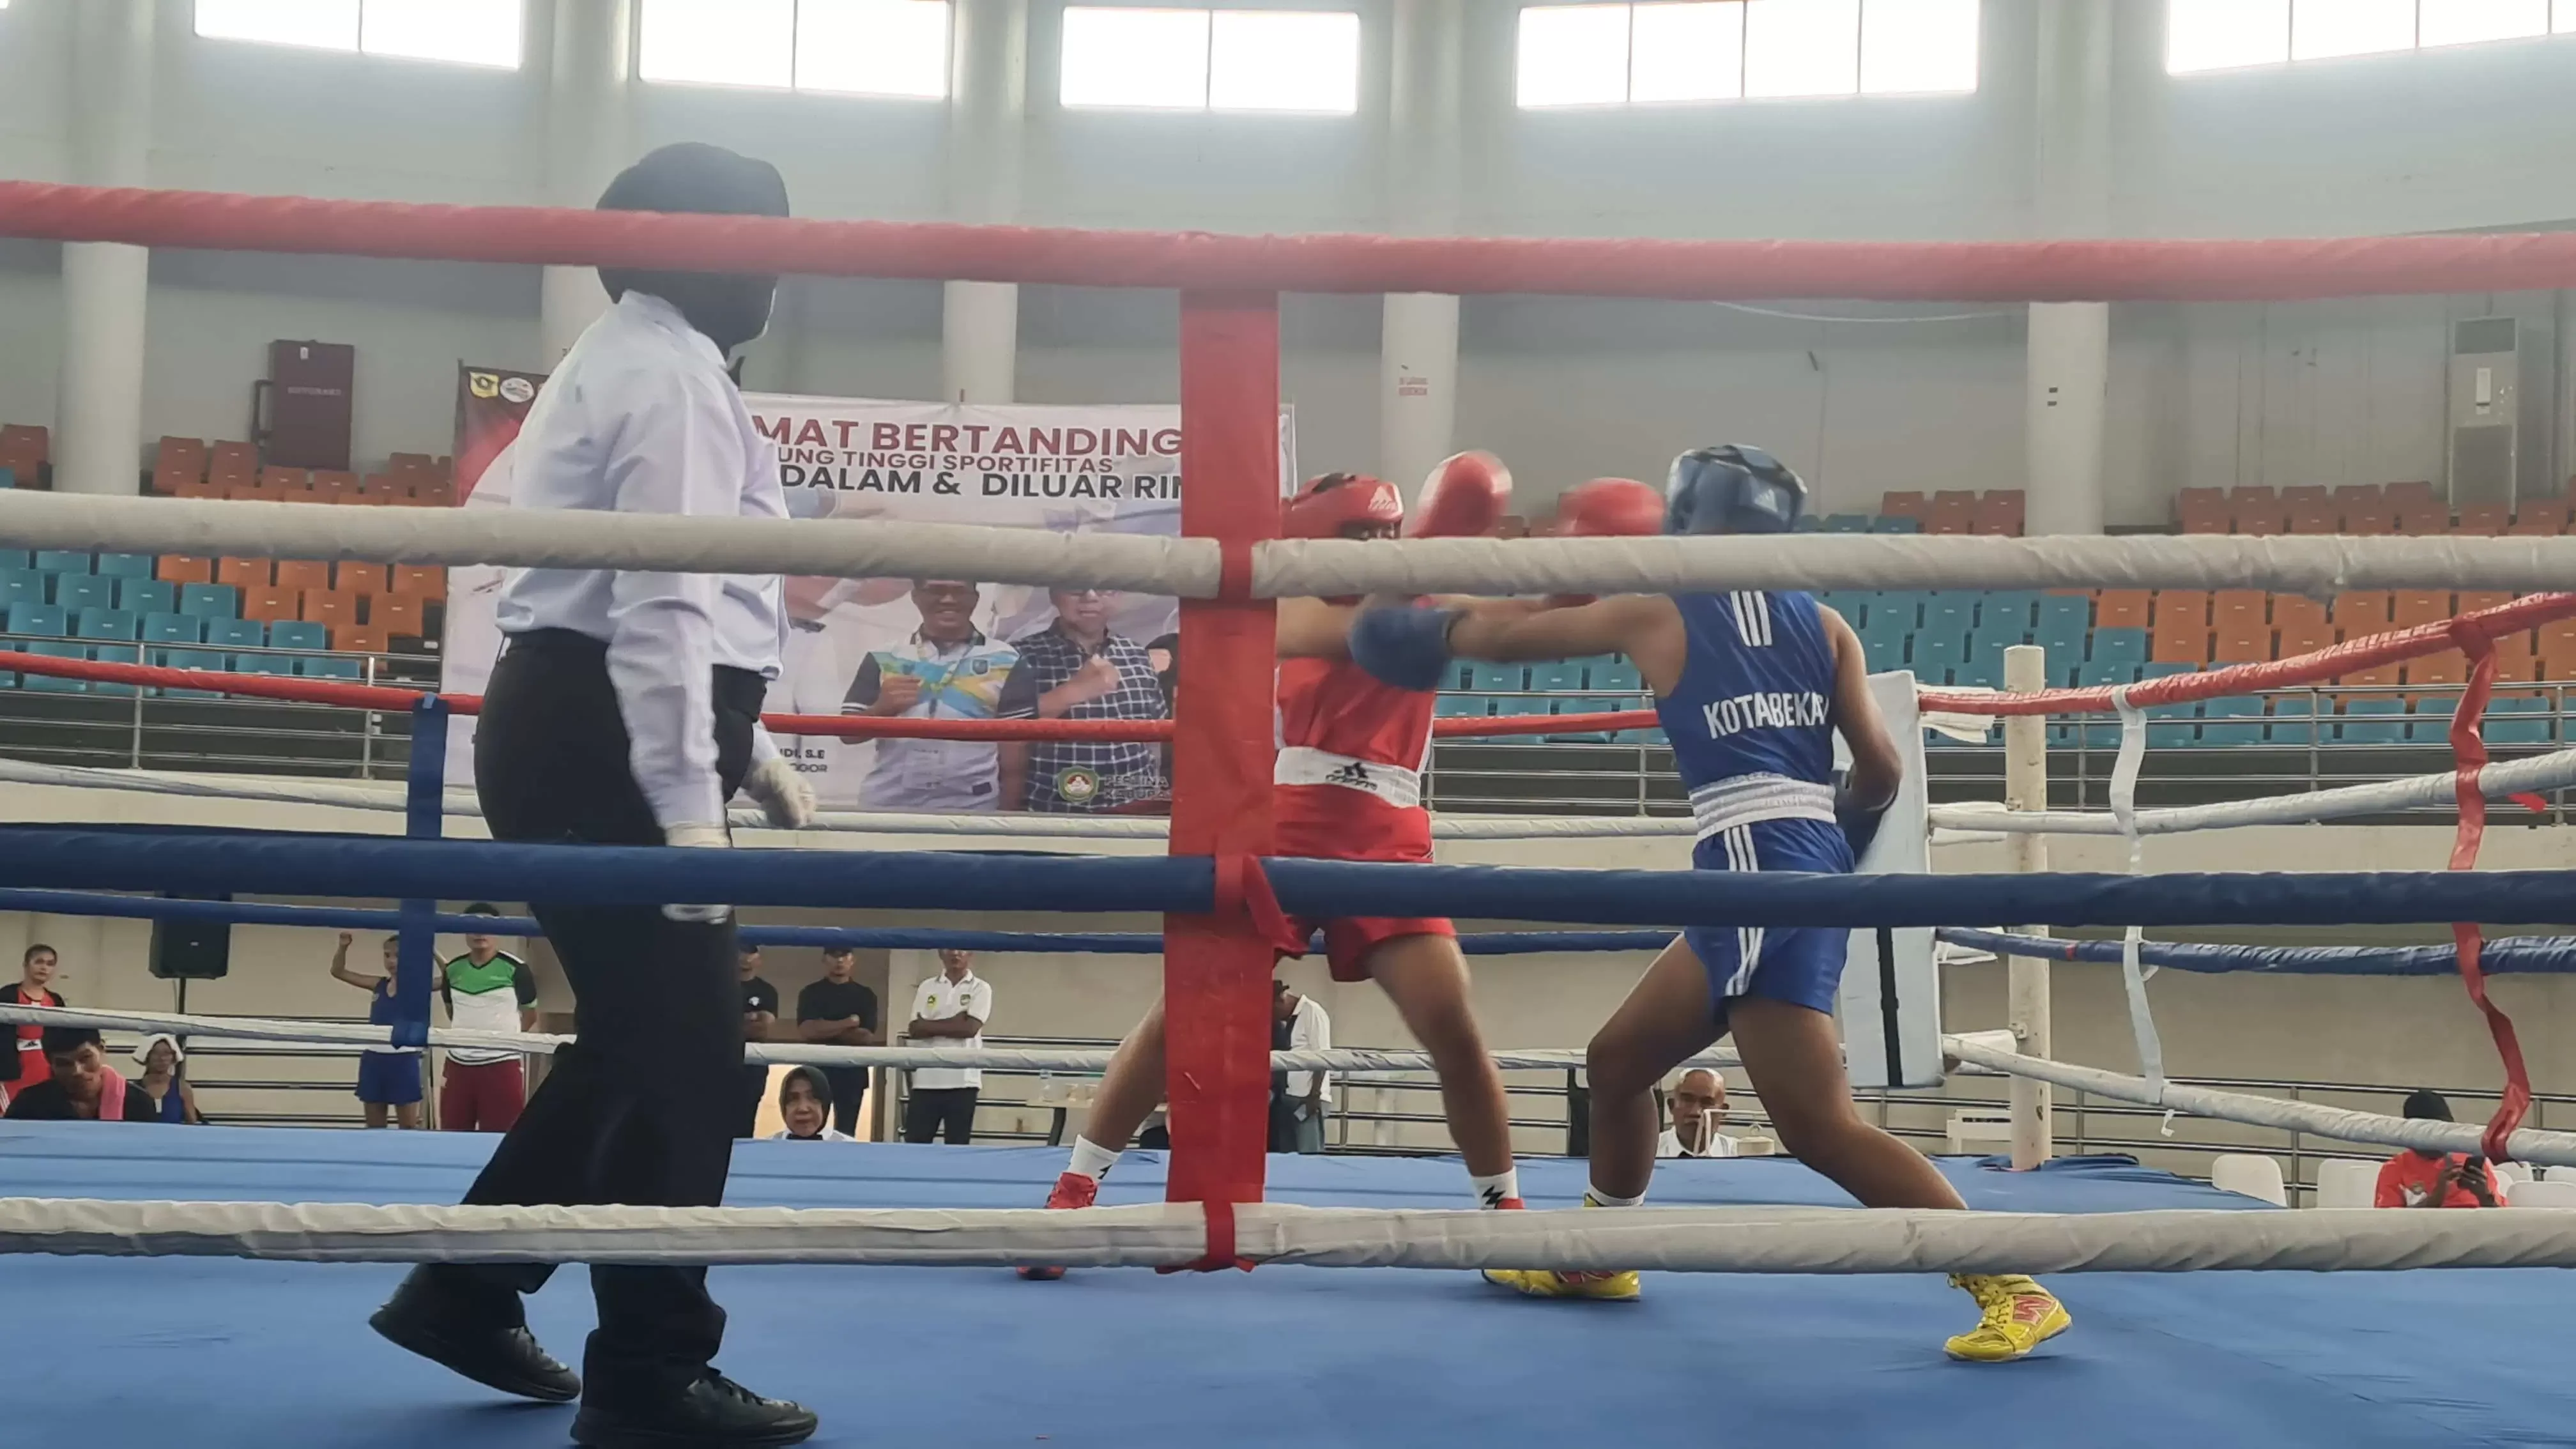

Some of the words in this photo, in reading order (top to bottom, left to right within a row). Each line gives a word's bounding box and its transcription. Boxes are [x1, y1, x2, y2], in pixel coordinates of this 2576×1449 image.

[872, 422, 1181, 456] BERTANDING
[843, 451, 934, 469] TINGGI
[943, 454, 1114, 473] SPORTIFITAS
[780, 464, 921, 494] DALAM
[932, 471, 962, 495] &
[982, 473, 1123, 498] DILUAR
